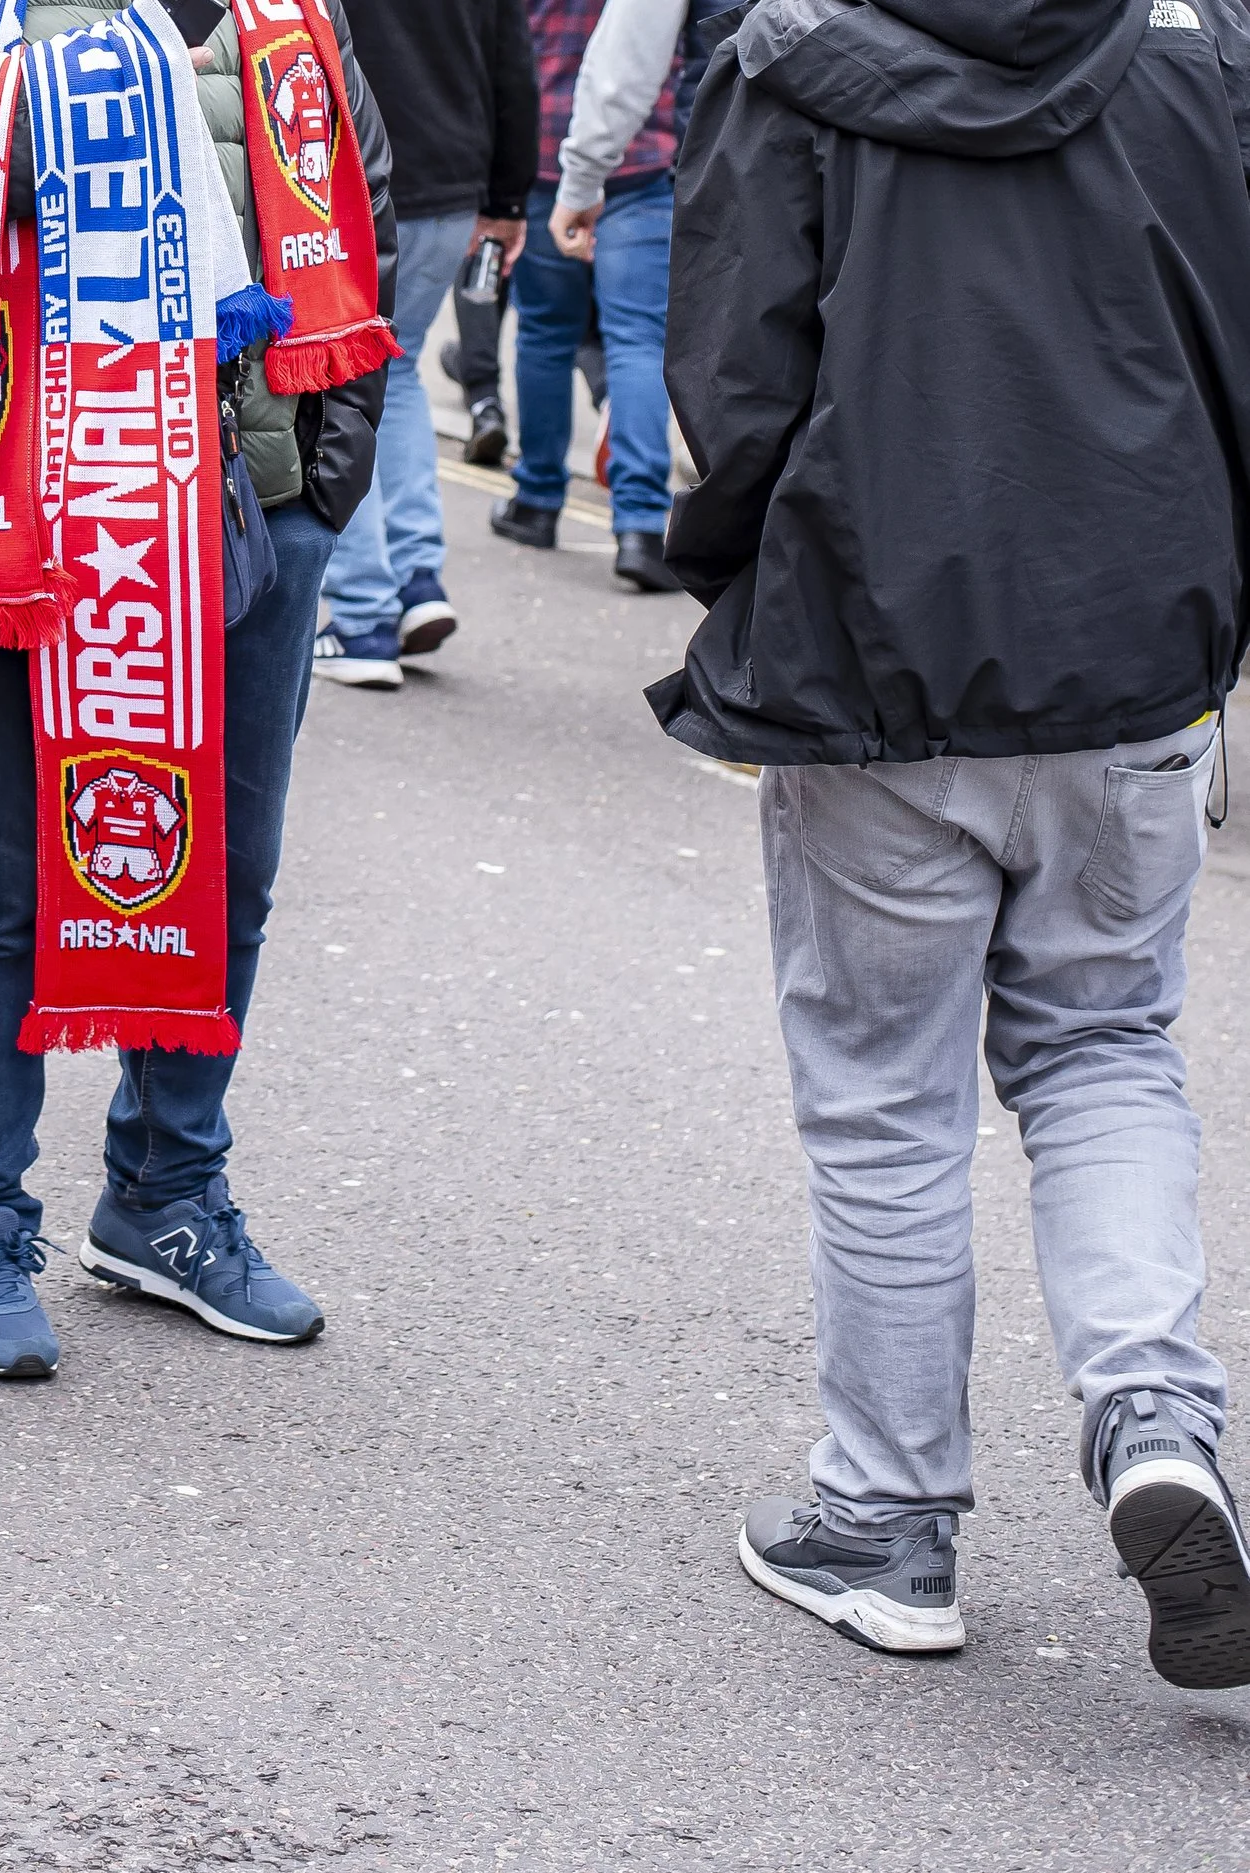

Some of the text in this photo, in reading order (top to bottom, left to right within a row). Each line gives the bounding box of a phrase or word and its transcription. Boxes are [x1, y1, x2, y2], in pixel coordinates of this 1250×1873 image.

[1152, 0, 1174, 10] THE
[1149, 18, 1180, 28] FACE
[63, 27, 149, 302] LEED
[41, 191, 70, 496] MATCHDAY LIVE
[155, 213, 194, 458] 01-04-2023
[1125, 1438, 1181, 1460] PUMA
[910, 1575, 952, 1595] PUMA
